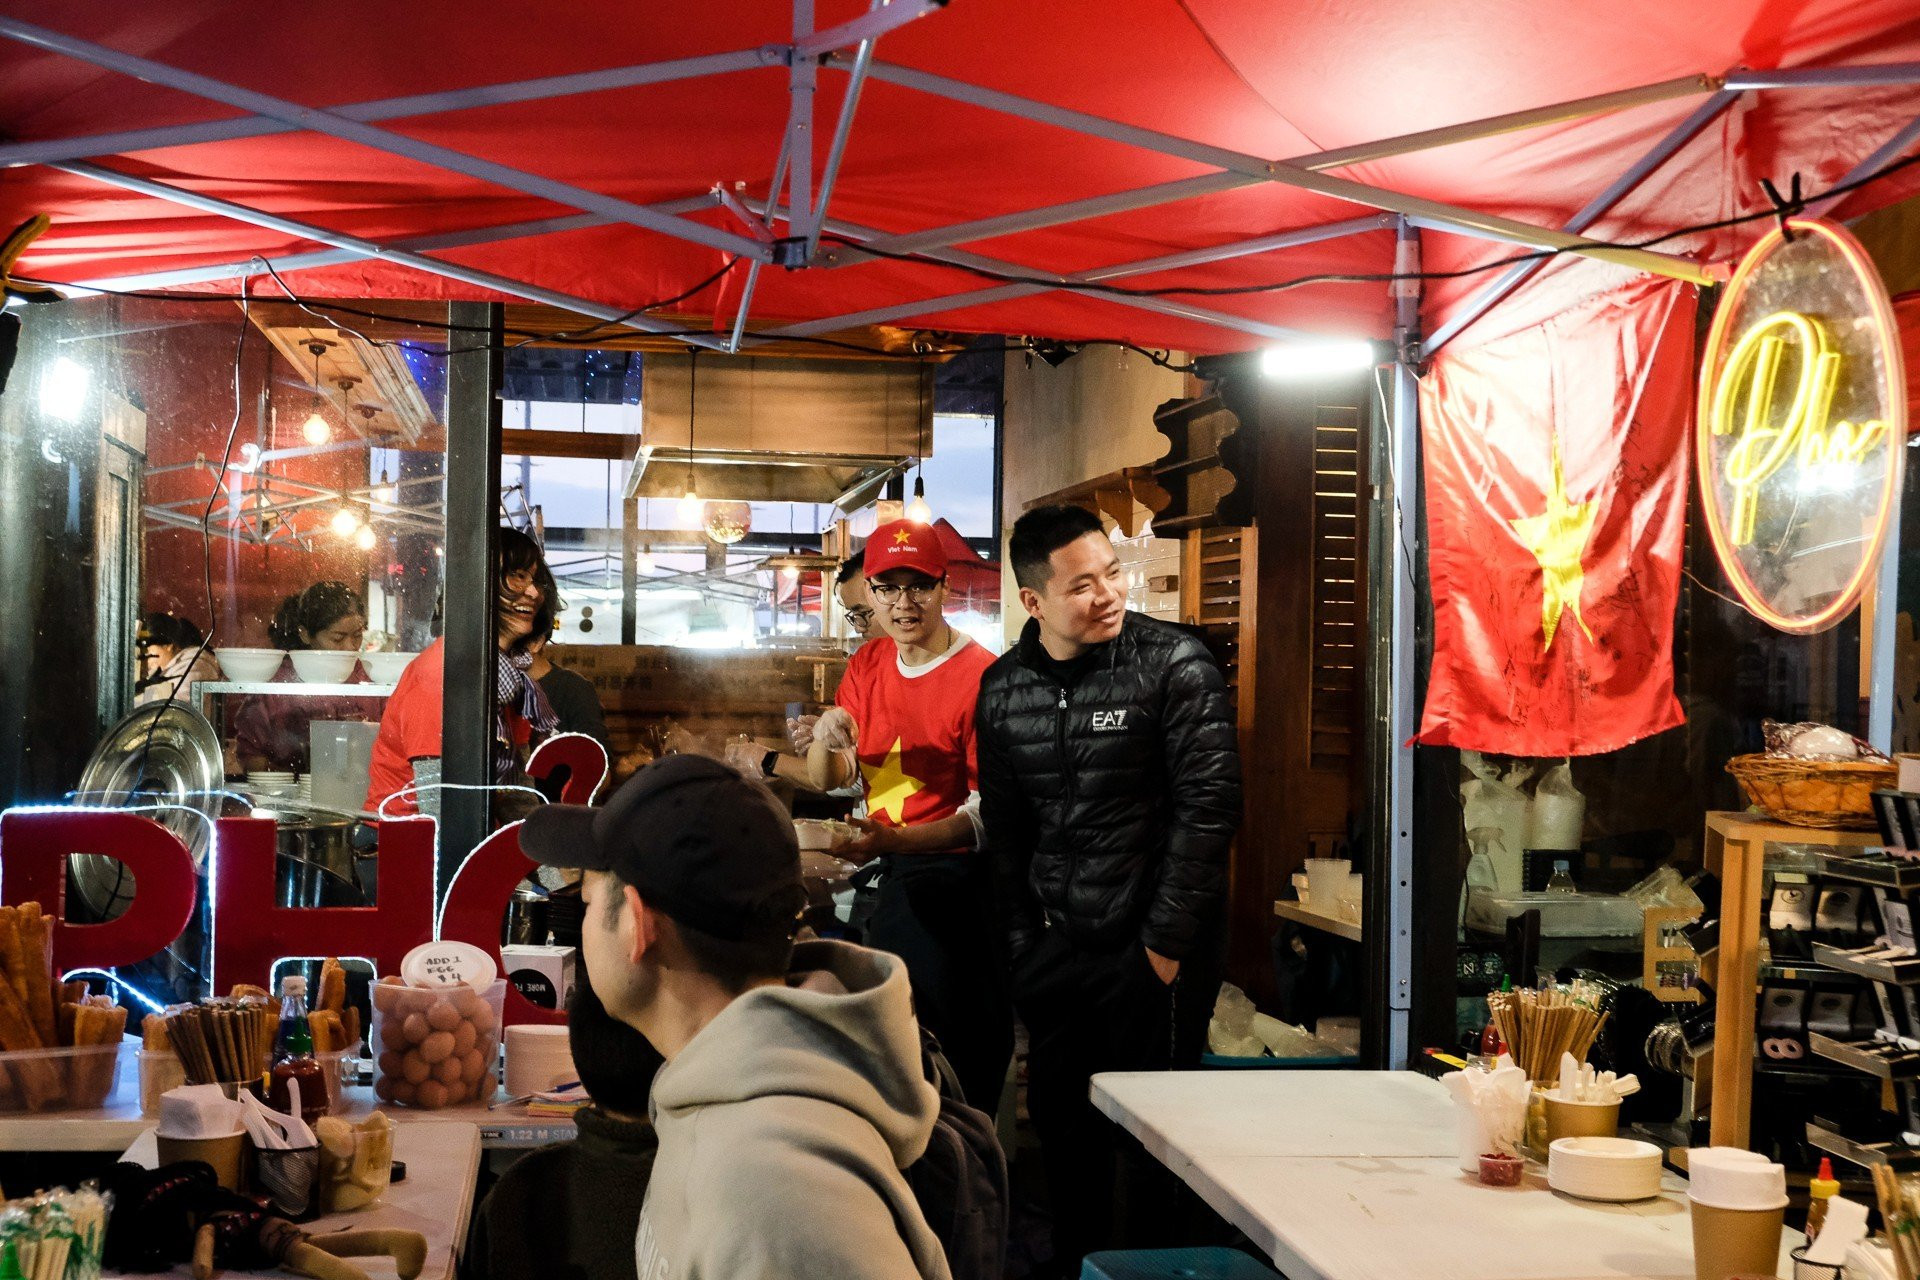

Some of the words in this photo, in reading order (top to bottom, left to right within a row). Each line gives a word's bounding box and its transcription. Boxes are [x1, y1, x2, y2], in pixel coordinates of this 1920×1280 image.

[1093, 710, 1127, 726] EA7
[426, 957, 451, 965] ADD
[526, 983, 546, 992] MORE
[510, 1129, 533, 1140] 1.22
[537, 1129, 549, 1139] M
